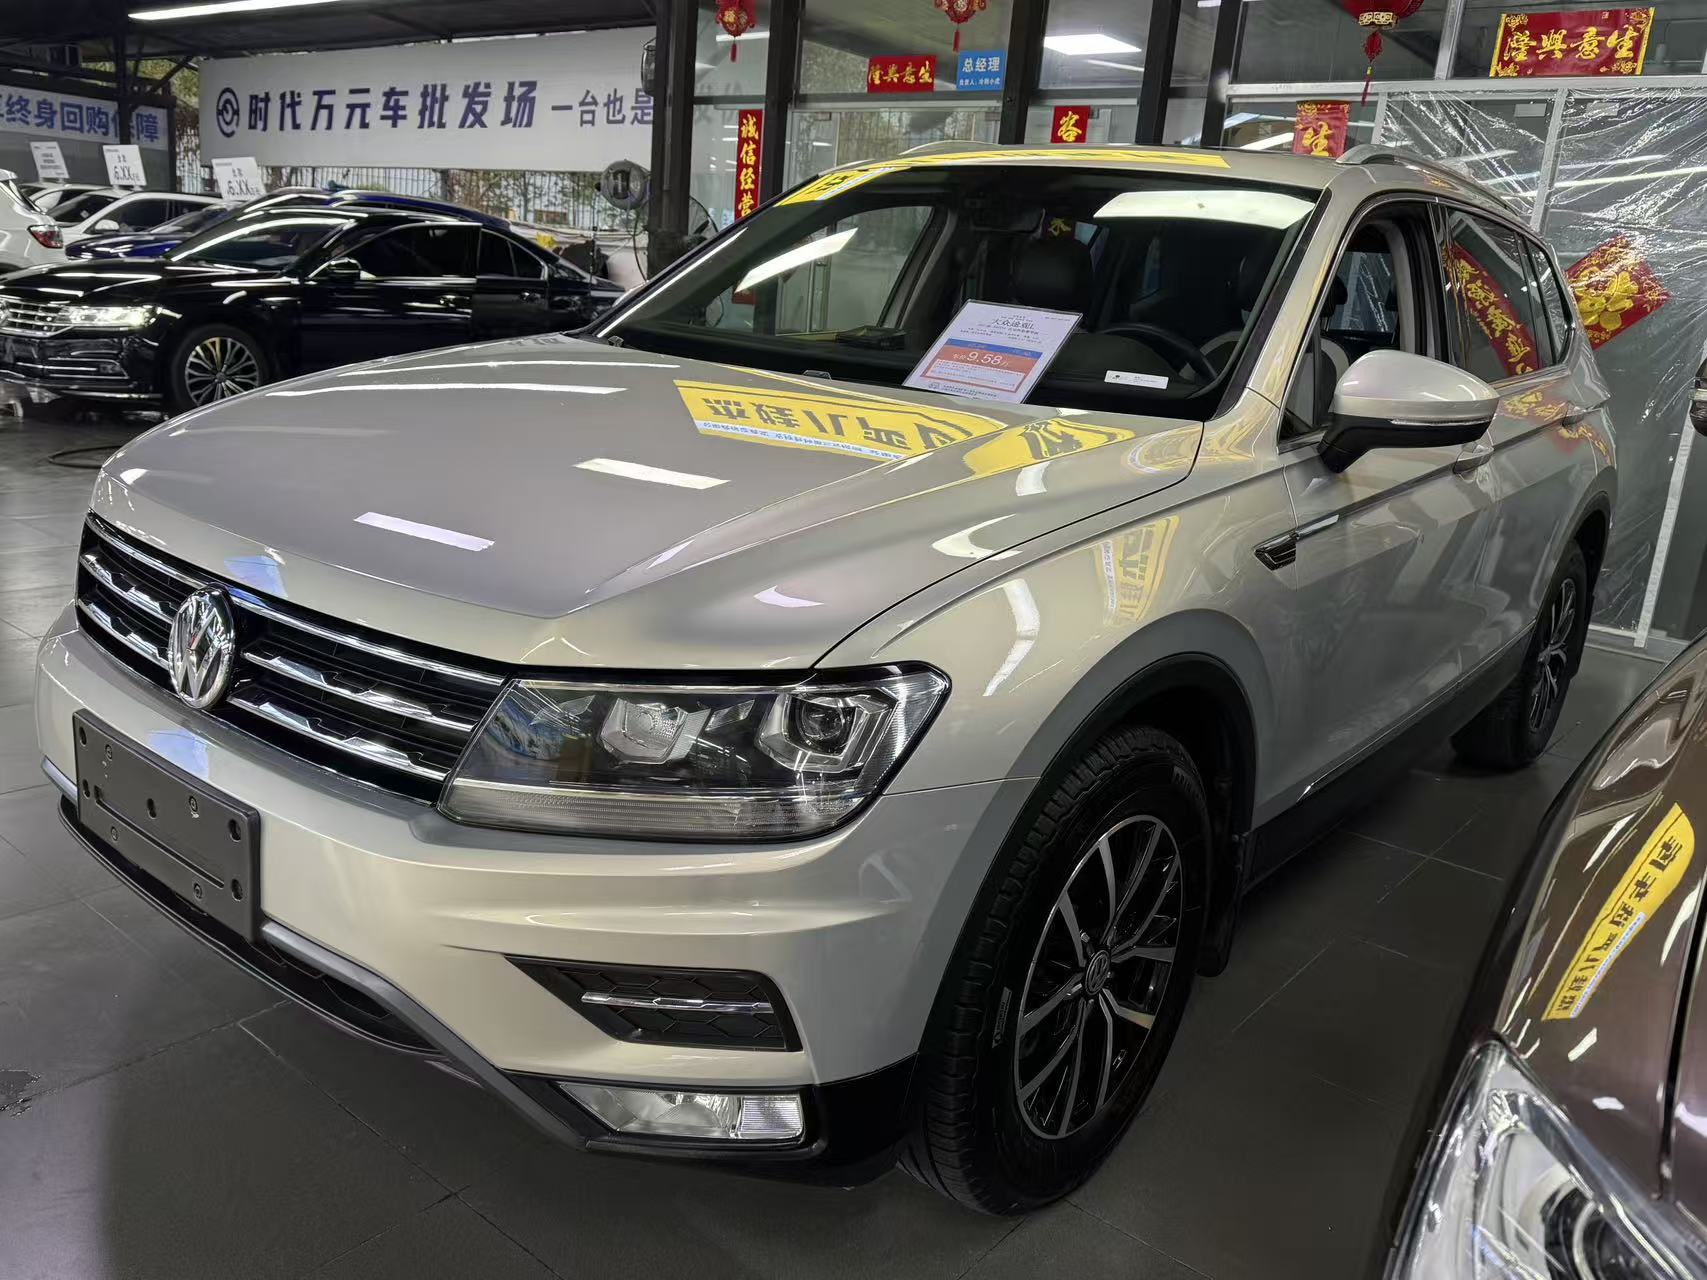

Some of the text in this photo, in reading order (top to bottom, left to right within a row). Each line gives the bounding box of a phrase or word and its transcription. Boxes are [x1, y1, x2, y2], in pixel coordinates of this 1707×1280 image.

[962, 57, 1000, 73] 总经理
[0, 94, 160, 142] 终身回购障
[248, 80, 538, 131] 时代万元车批发场
[966, 351, 1003, 366] 9.58
